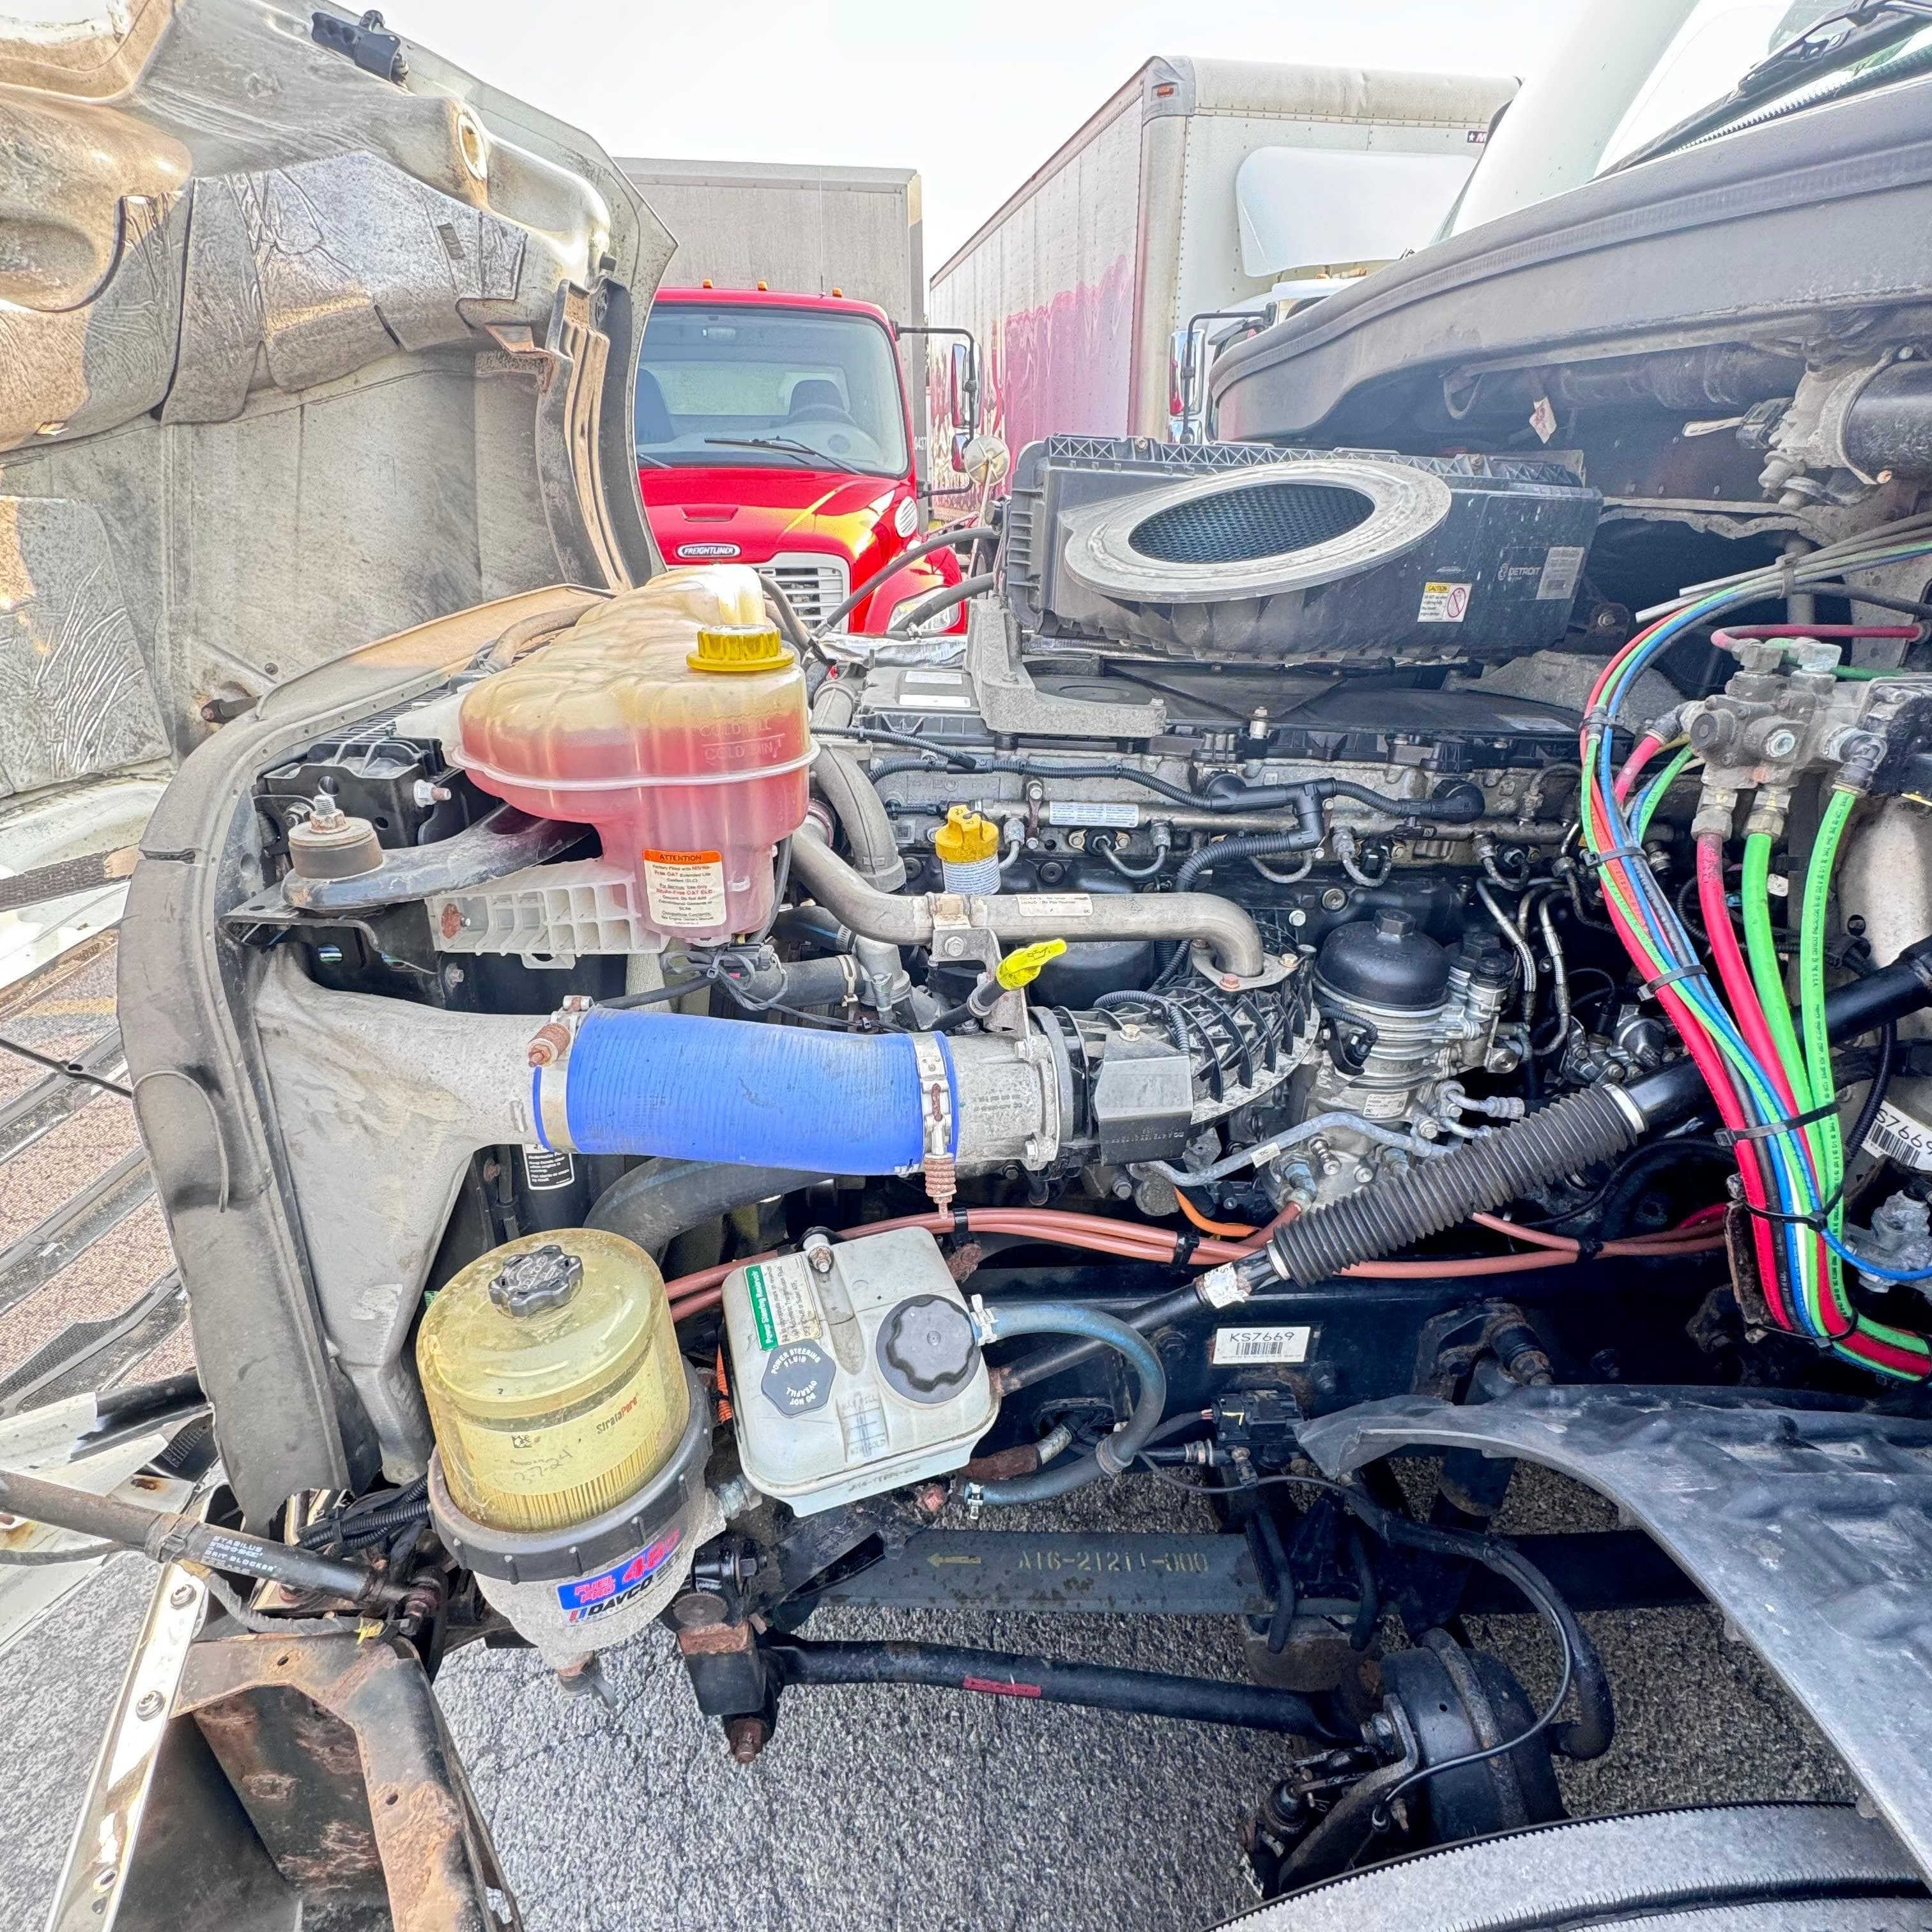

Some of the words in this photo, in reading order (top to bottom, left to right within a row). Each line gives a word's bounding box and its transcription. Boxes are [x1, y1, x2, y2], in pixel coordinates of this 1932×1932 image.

[1508, 567, 1542, 576] DETROIT
[704, 745, 744, 760] COLD
[758, 1298, 770, 1324] Steering
[763, 1323, 774, 1344] Power
[1230, 1331, 1294, 1342] KS7669
[771, 1352, 789, 1374] POWER
[789, 1347, 822, 1363] STEERING
[783, 1355, 806, 1367] FLUID
[786, 1380, 818, 1398] OVERFILL
[806, 1392, 816, 1403] DO
[596, 1395, 638, 1435] StrataPore
[212, 1535, 263, 1552] STABILUS
[1018, 1551, 1209, 1572] A16-21211-000
[574, 1574, 617, 1596] FUEL
[580, 1584, 616, 1604] PRO
[588, 1574, 654, 1616] DAVCO
